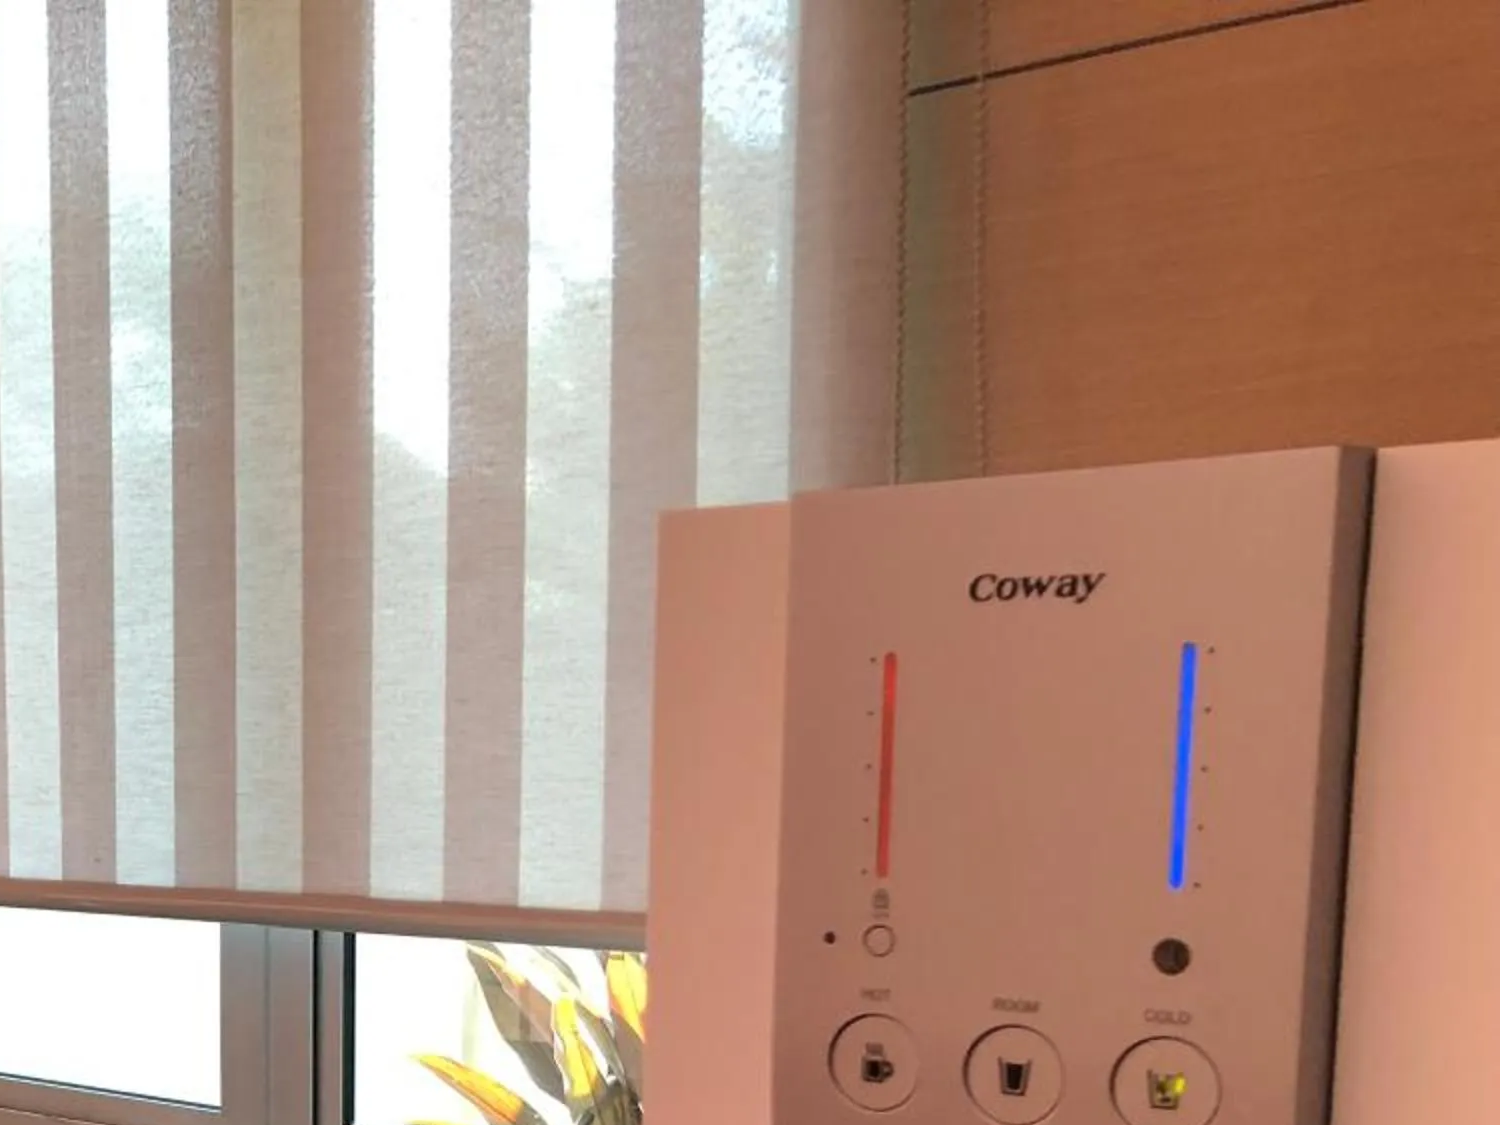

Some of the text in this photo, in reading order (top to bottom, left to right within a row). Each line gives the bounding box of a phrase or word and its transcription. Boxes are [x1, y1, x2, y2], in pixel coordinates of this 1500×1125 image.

[969, 572, 1106, 604] Coway
[992, 998, 1041, 1013] ROOM
[1143, 1008, 1193, 1025] COLD
